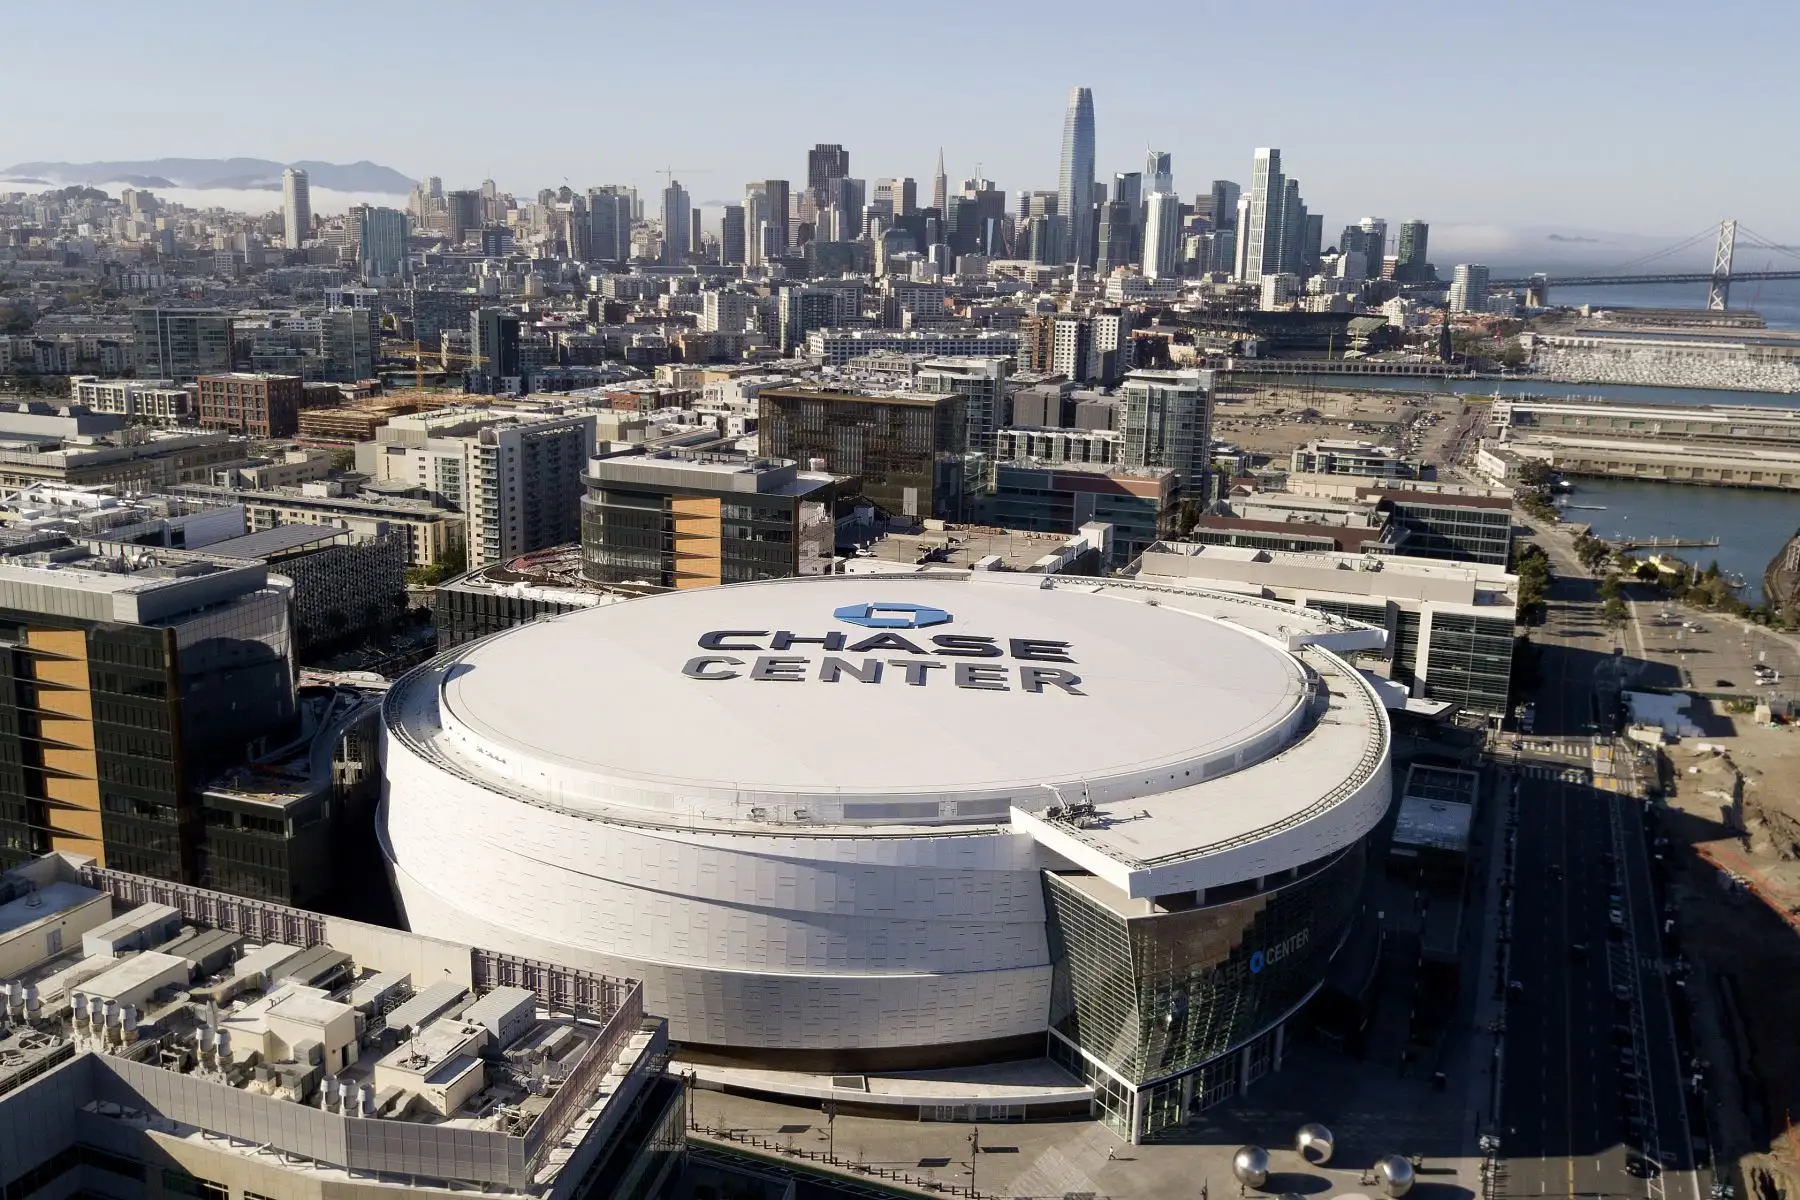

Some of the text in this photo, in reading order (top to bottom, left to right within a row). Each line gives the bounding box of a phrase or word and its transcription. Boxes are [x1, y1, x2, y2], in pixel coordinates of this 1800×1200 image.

[697, 630, 1078, 663] CHASE
[681, 656, 1089, 696] CENTER
[1266, 928, 1309, 965] CENTER
